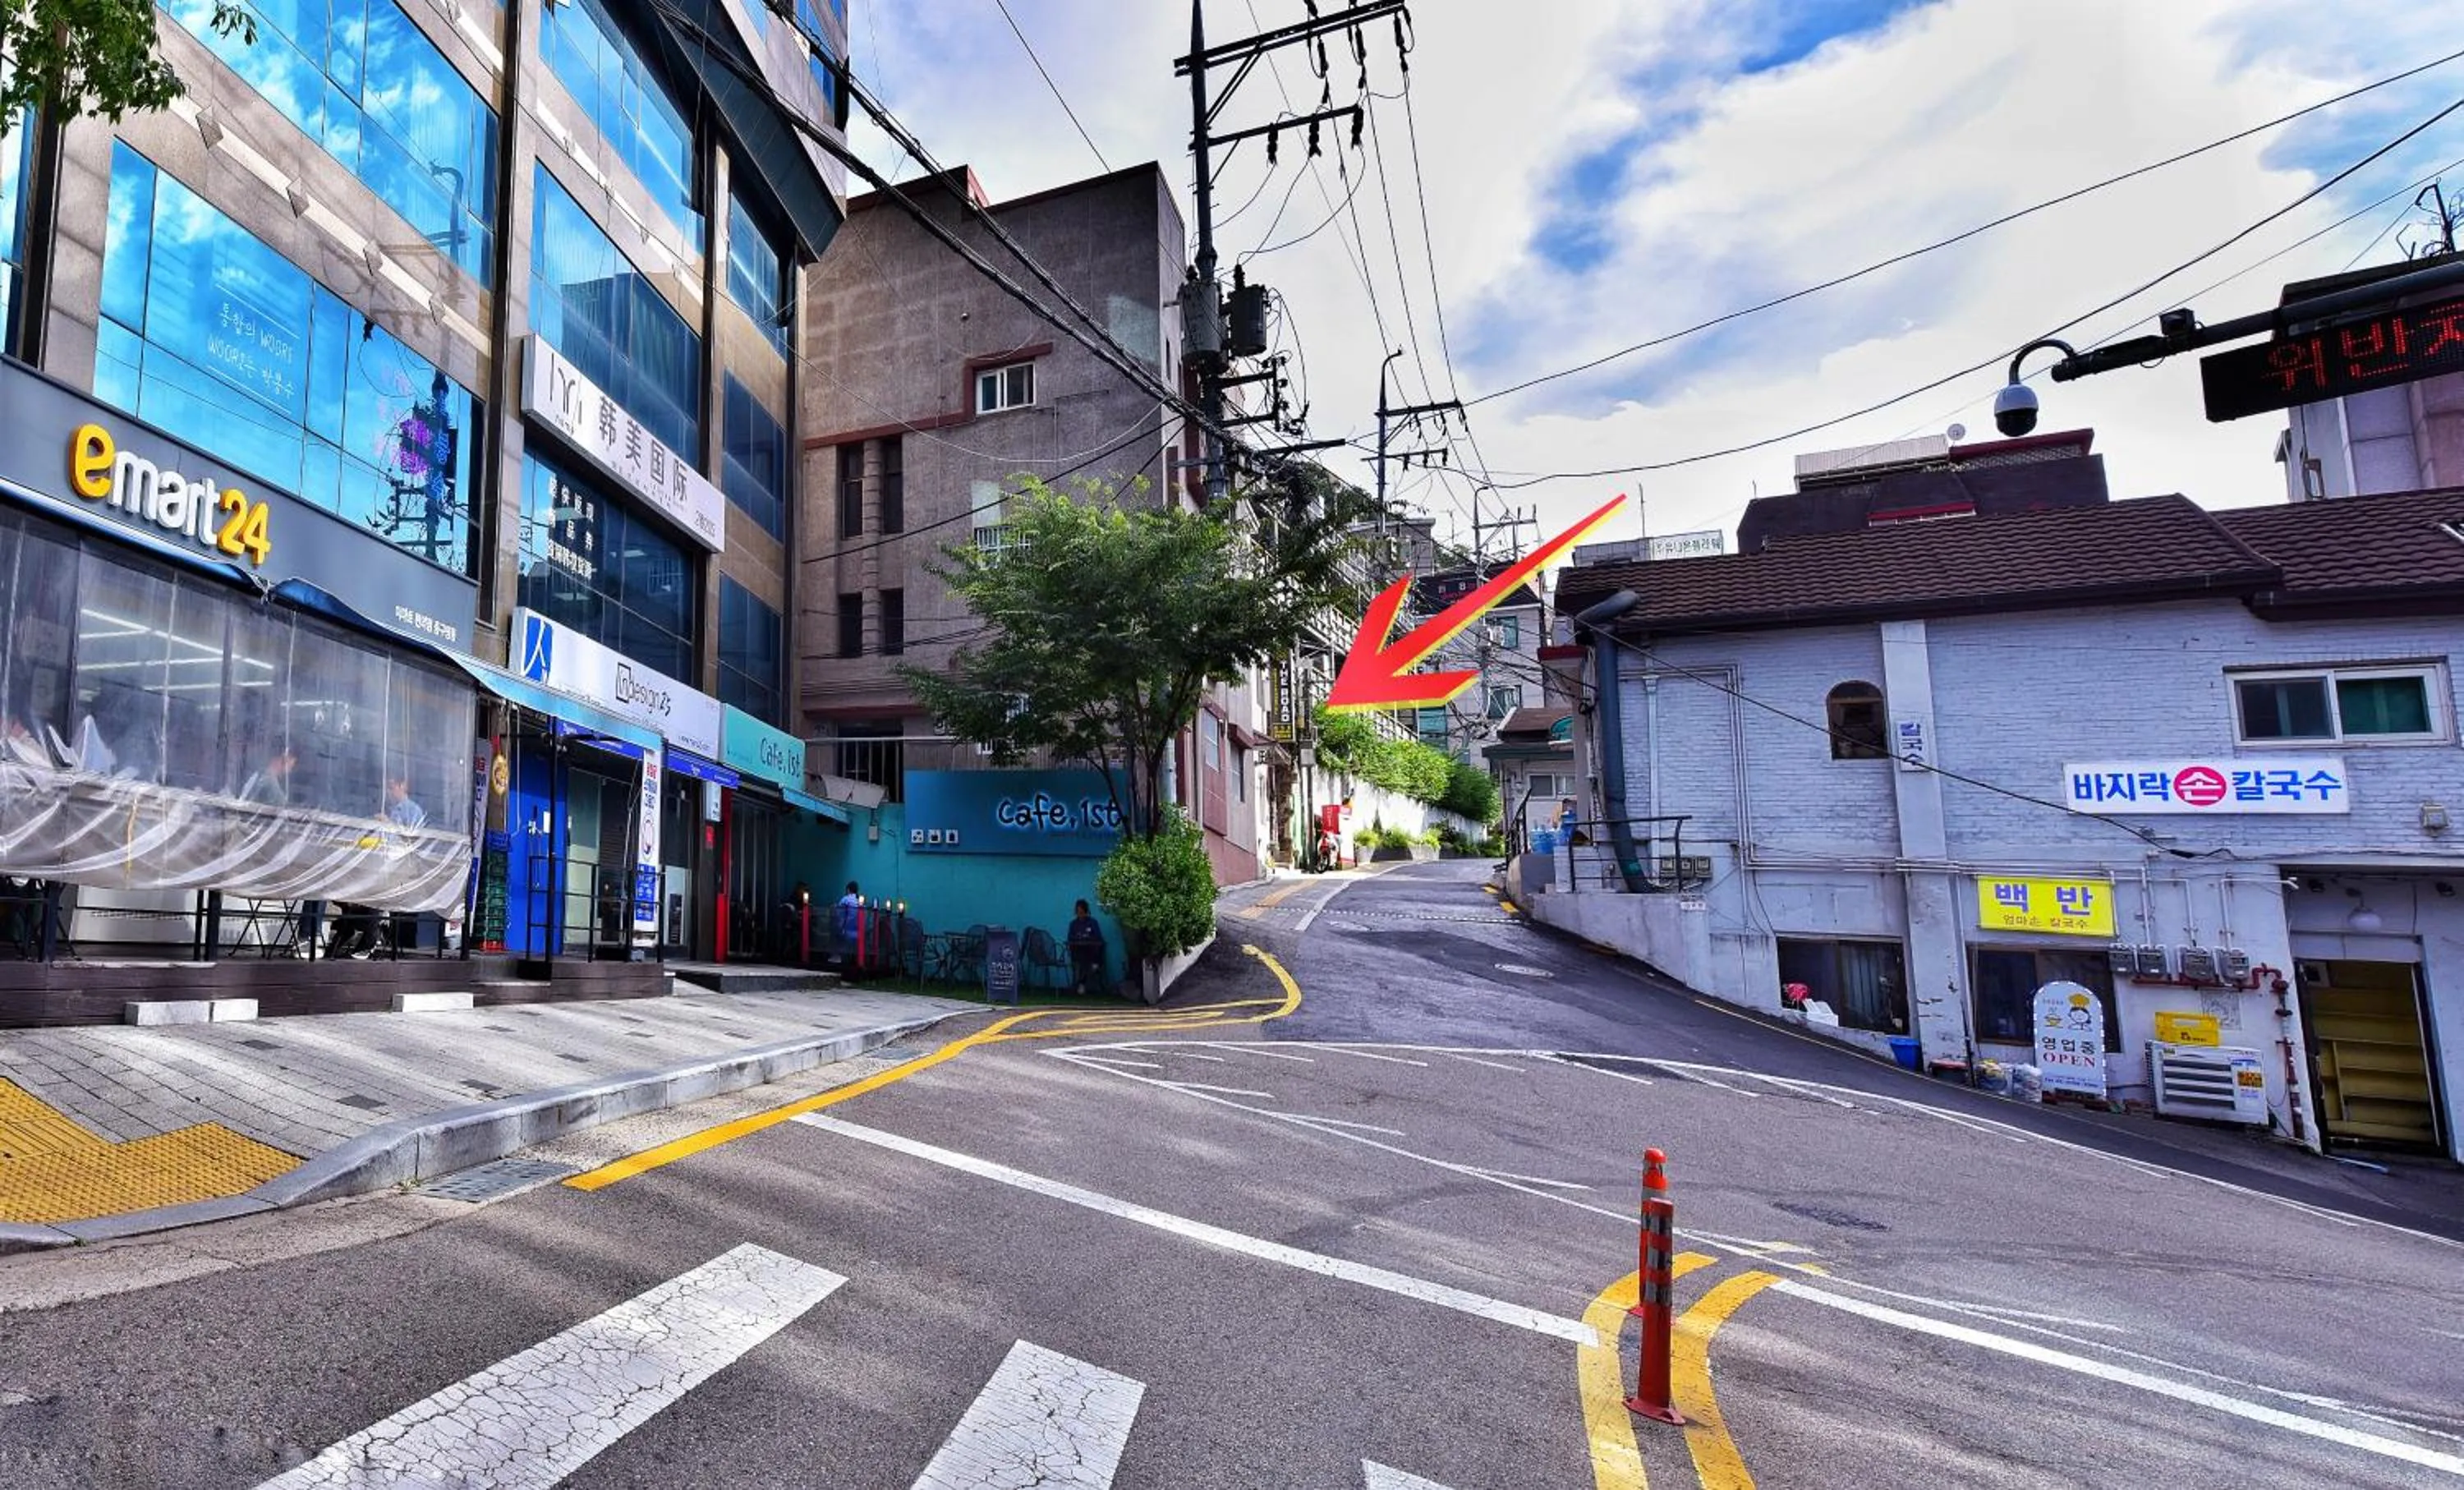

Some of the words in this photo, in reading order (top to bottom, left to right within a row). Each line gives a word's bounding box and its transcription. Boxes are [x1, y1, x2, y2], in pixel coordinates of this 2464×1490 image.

[69, 423, 273, 565] emart24
[1279, 661, 1289, 686] THE
[1280, 688, 1291, 722] ROAD
[2073, 771, 2171, 802] 바지락
[2178, 769, 2223, 802] 손
[2231, 770, 2342, 802] 칼국수
[2049, 917, 2089, 930] 칼국수
[2041, 1036, 2096, 1055] 영업중
[2043, 1052, 2096, 1069] OPEN
